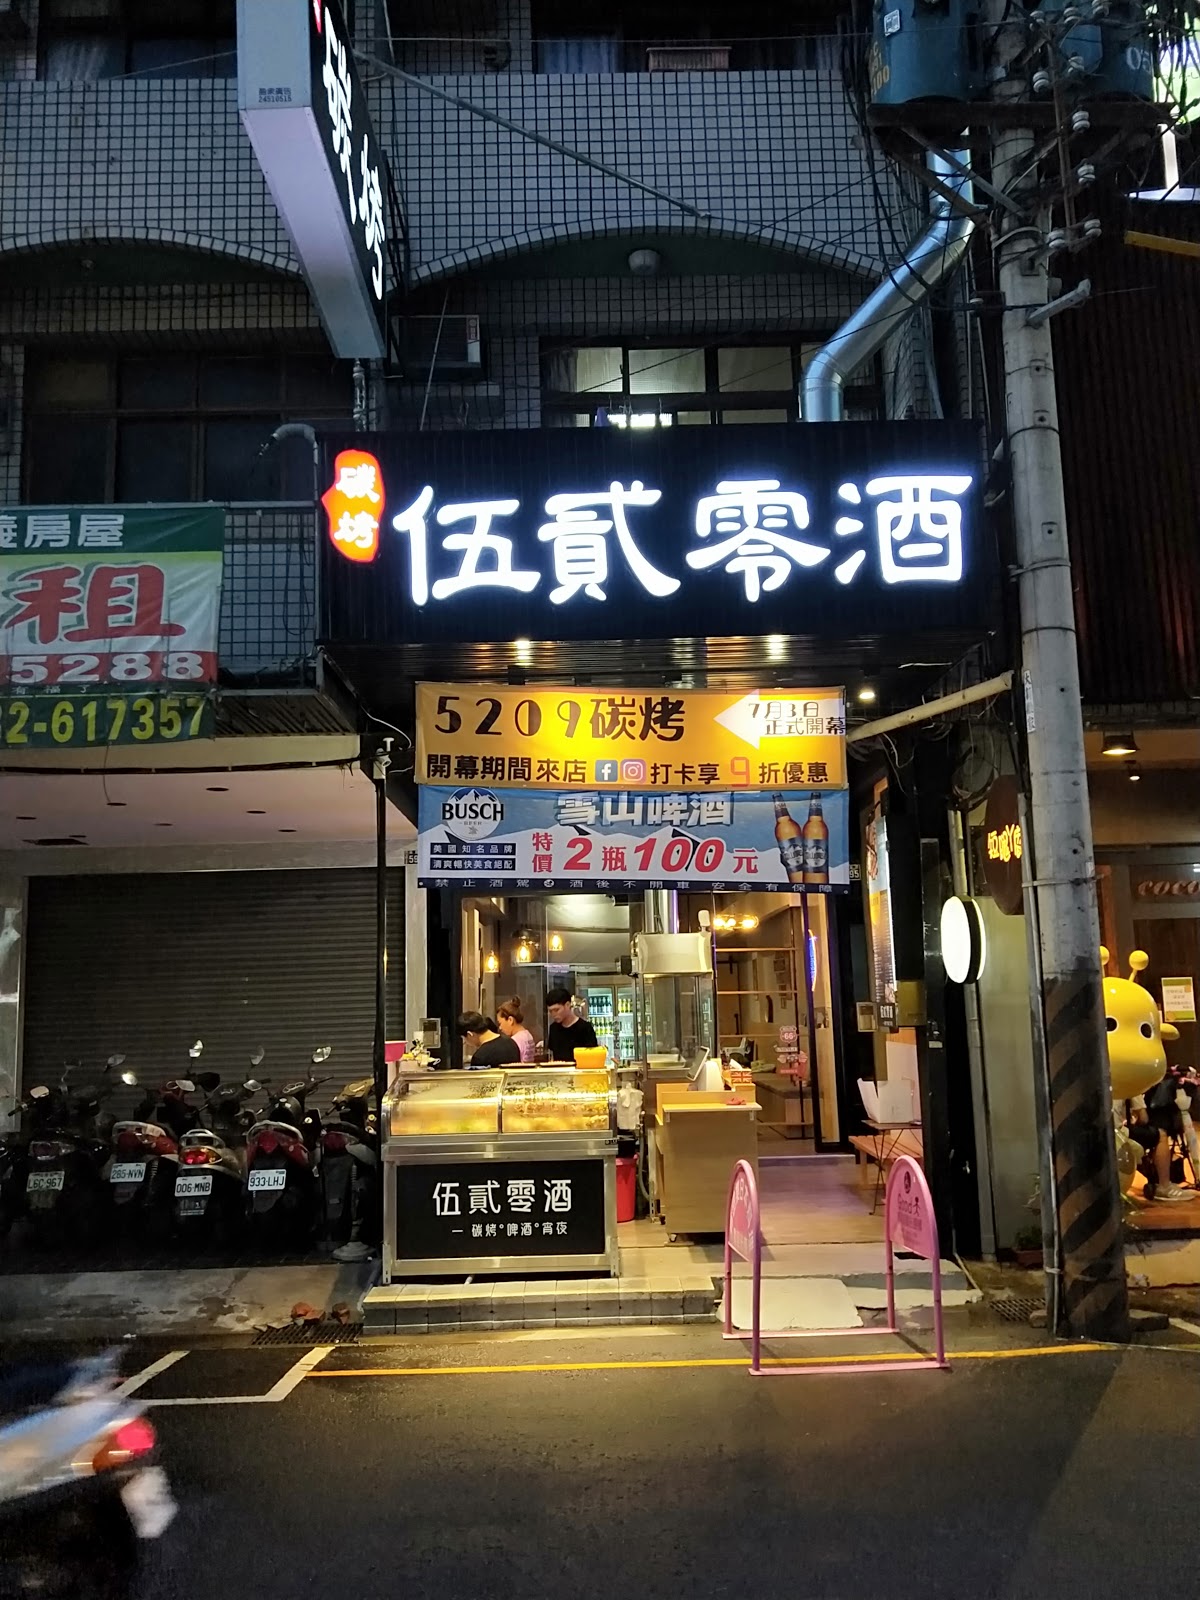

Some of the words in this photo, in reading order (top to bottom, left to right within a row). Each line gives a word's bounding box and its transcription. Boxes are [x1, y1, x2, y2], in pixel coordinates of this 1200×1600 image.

[393, 474, 973, 607] 伍貳零酒
[4, 564, 187, 645] 租
[0, 696, 207, 744] 2-617357
[434, 694, 686, 742] 5209碳烤
[748, 700, 819, 719] 7月3日
[764, 716, 846, 736] 正式開幕
[426, 753, 588, 784] 開幕期間來店
[442, 802, 505, 821] BUSCH
[556, 790, 732, 828] 雪山啤酒
[433, 844, 514, 854] 美國知名品牌
[532, 832, 553, 873] 特價
[176, 1182, 211, 1193] 006-MNB
[249, 1176, 285, 1187] 933-LHJ
[432, 1179, 572, 1216] 伍貳零酒
